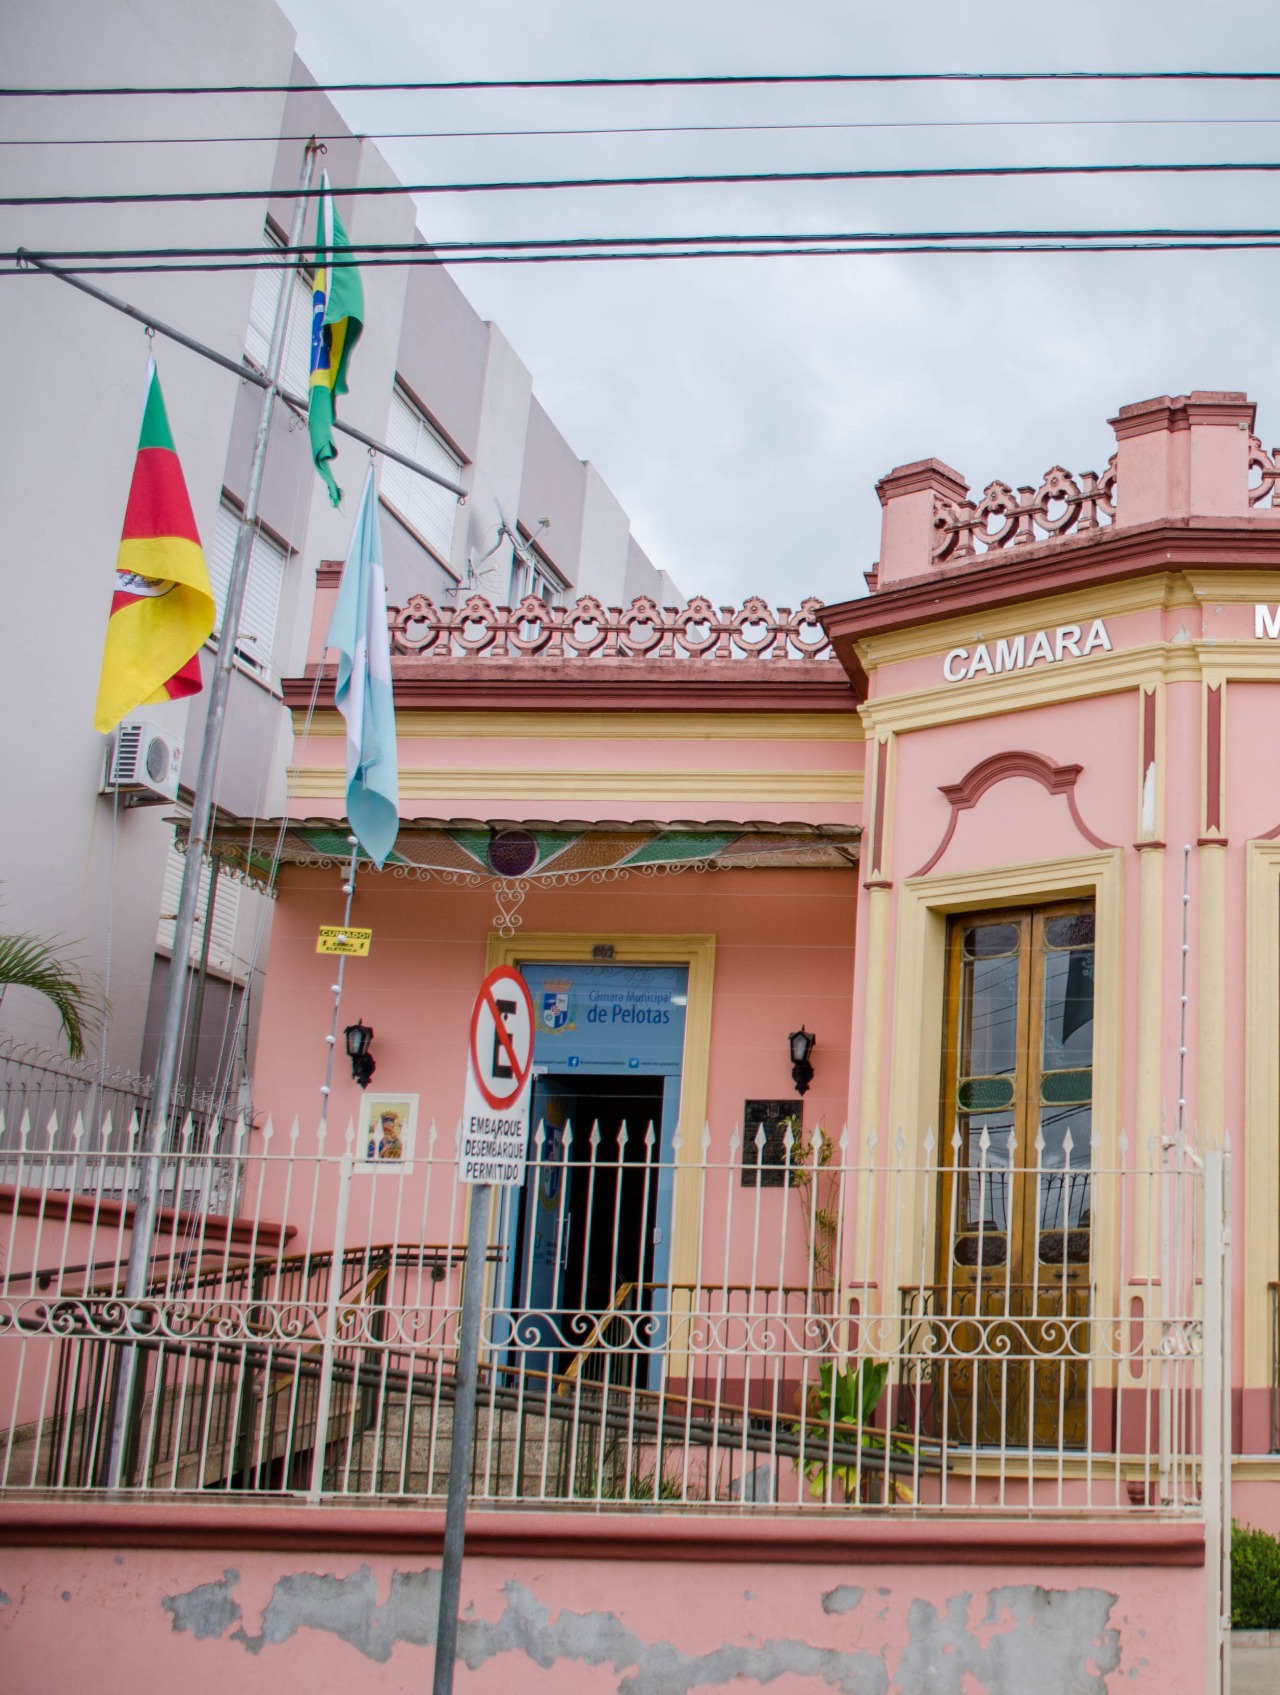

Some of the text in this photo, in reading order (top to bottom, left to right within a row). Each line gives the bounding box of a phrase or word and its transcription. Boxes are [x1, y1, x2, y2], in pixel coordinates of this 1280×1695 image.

[943, 618, 1112, 682] CAMARA
[627, 991, 672, 1005] Municipal
[587, 1004, 670, 1024] de Pelotas
[470, 1117, 522, 1137] EMBARQUE
[465, 1139, 524, 1159] DESEMBARQUE
[466, 1162, 519, 1180] PERMITIDO
